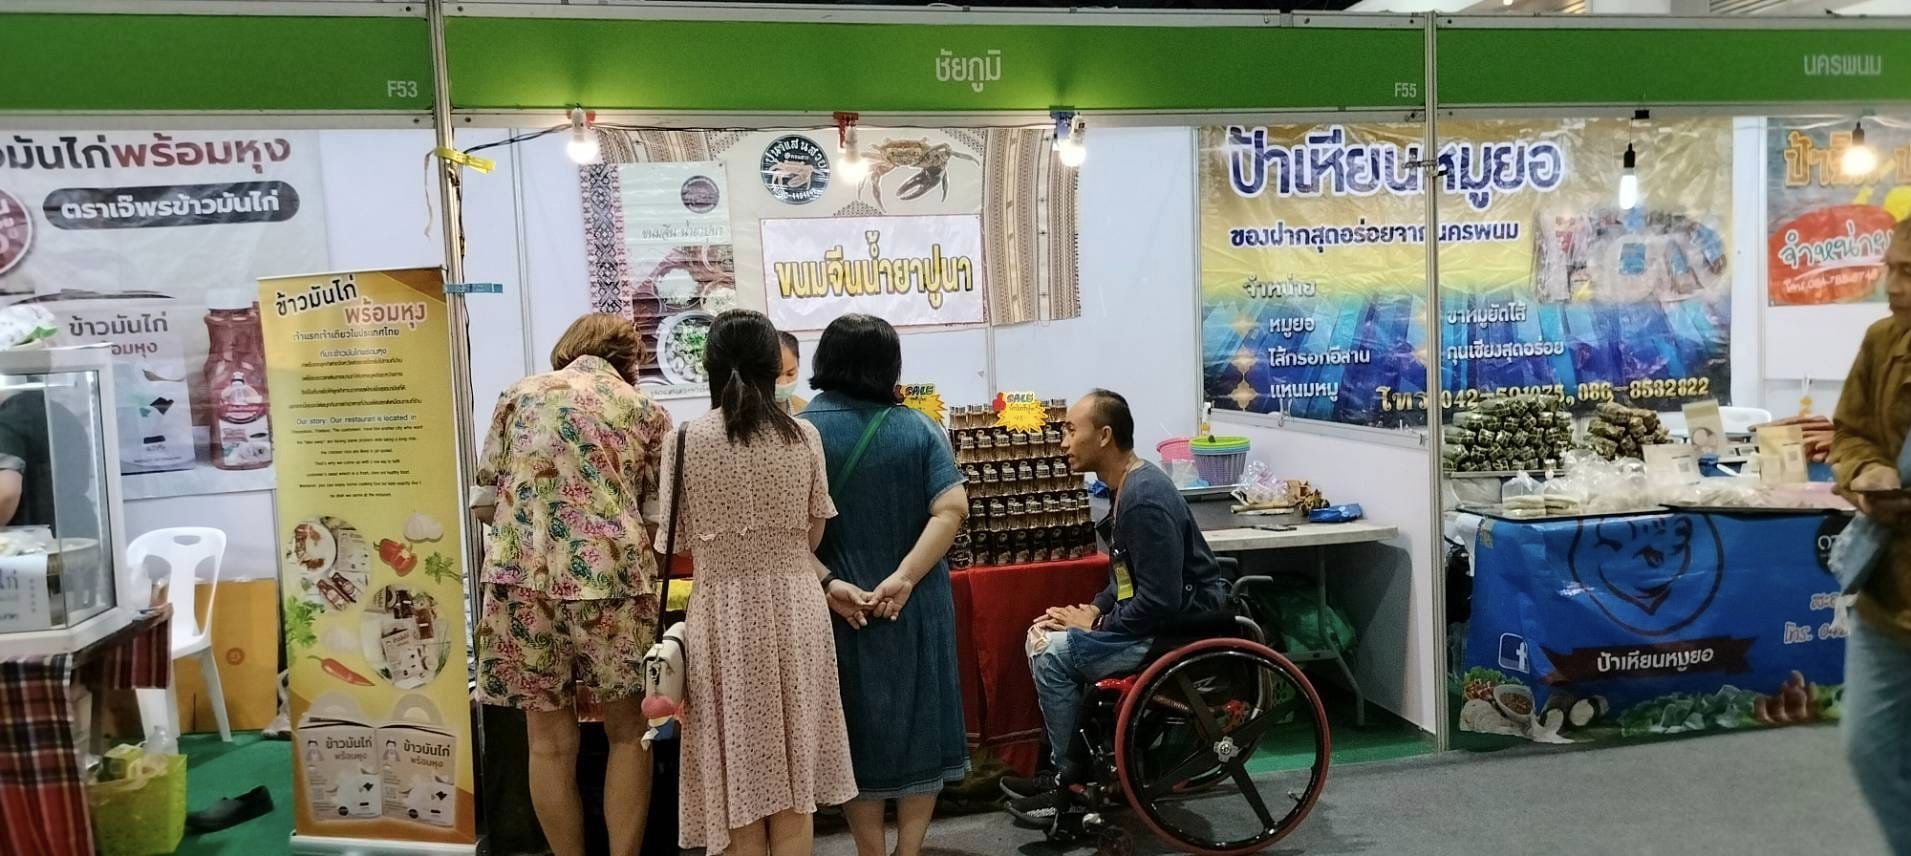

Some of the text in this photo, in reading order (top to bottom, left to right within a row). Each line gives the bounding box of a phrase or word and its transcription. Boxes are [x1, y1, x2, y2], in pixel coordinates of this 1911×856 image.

[935, 48, 1001, 92] ชัยภูมิ
[1803, 54, 1882, 75] นครพนม
[387, 79, 418, 98] F53
[1394, 82, 1417, 98] F55
[774, 230, 974, 310] ขนมจีนน้ำยาปูนา
[275, 274, 358, 316] ข้าวมันไก่
[1245, 275, 1316, 298] จำหน่าย
[69, 311, 168, 337] ข้าวมันไก่
[345, 298, 426, 329] พร้อมหุง
[1447, 303, 1527, 328] ขาหมูยัดไส้
[1268, 315, 1316, 339] หมูยอ
[1268, 347, 1371, 368] ไส้กรอกอีสาน
[1447, 338, 1565, 367] กุนเชียงสุดอร่อย
[1270, 382, 1340, 401] แหนมหมู
[1596, 645, 1715, 673] ป้าเหียนหมูยอ
